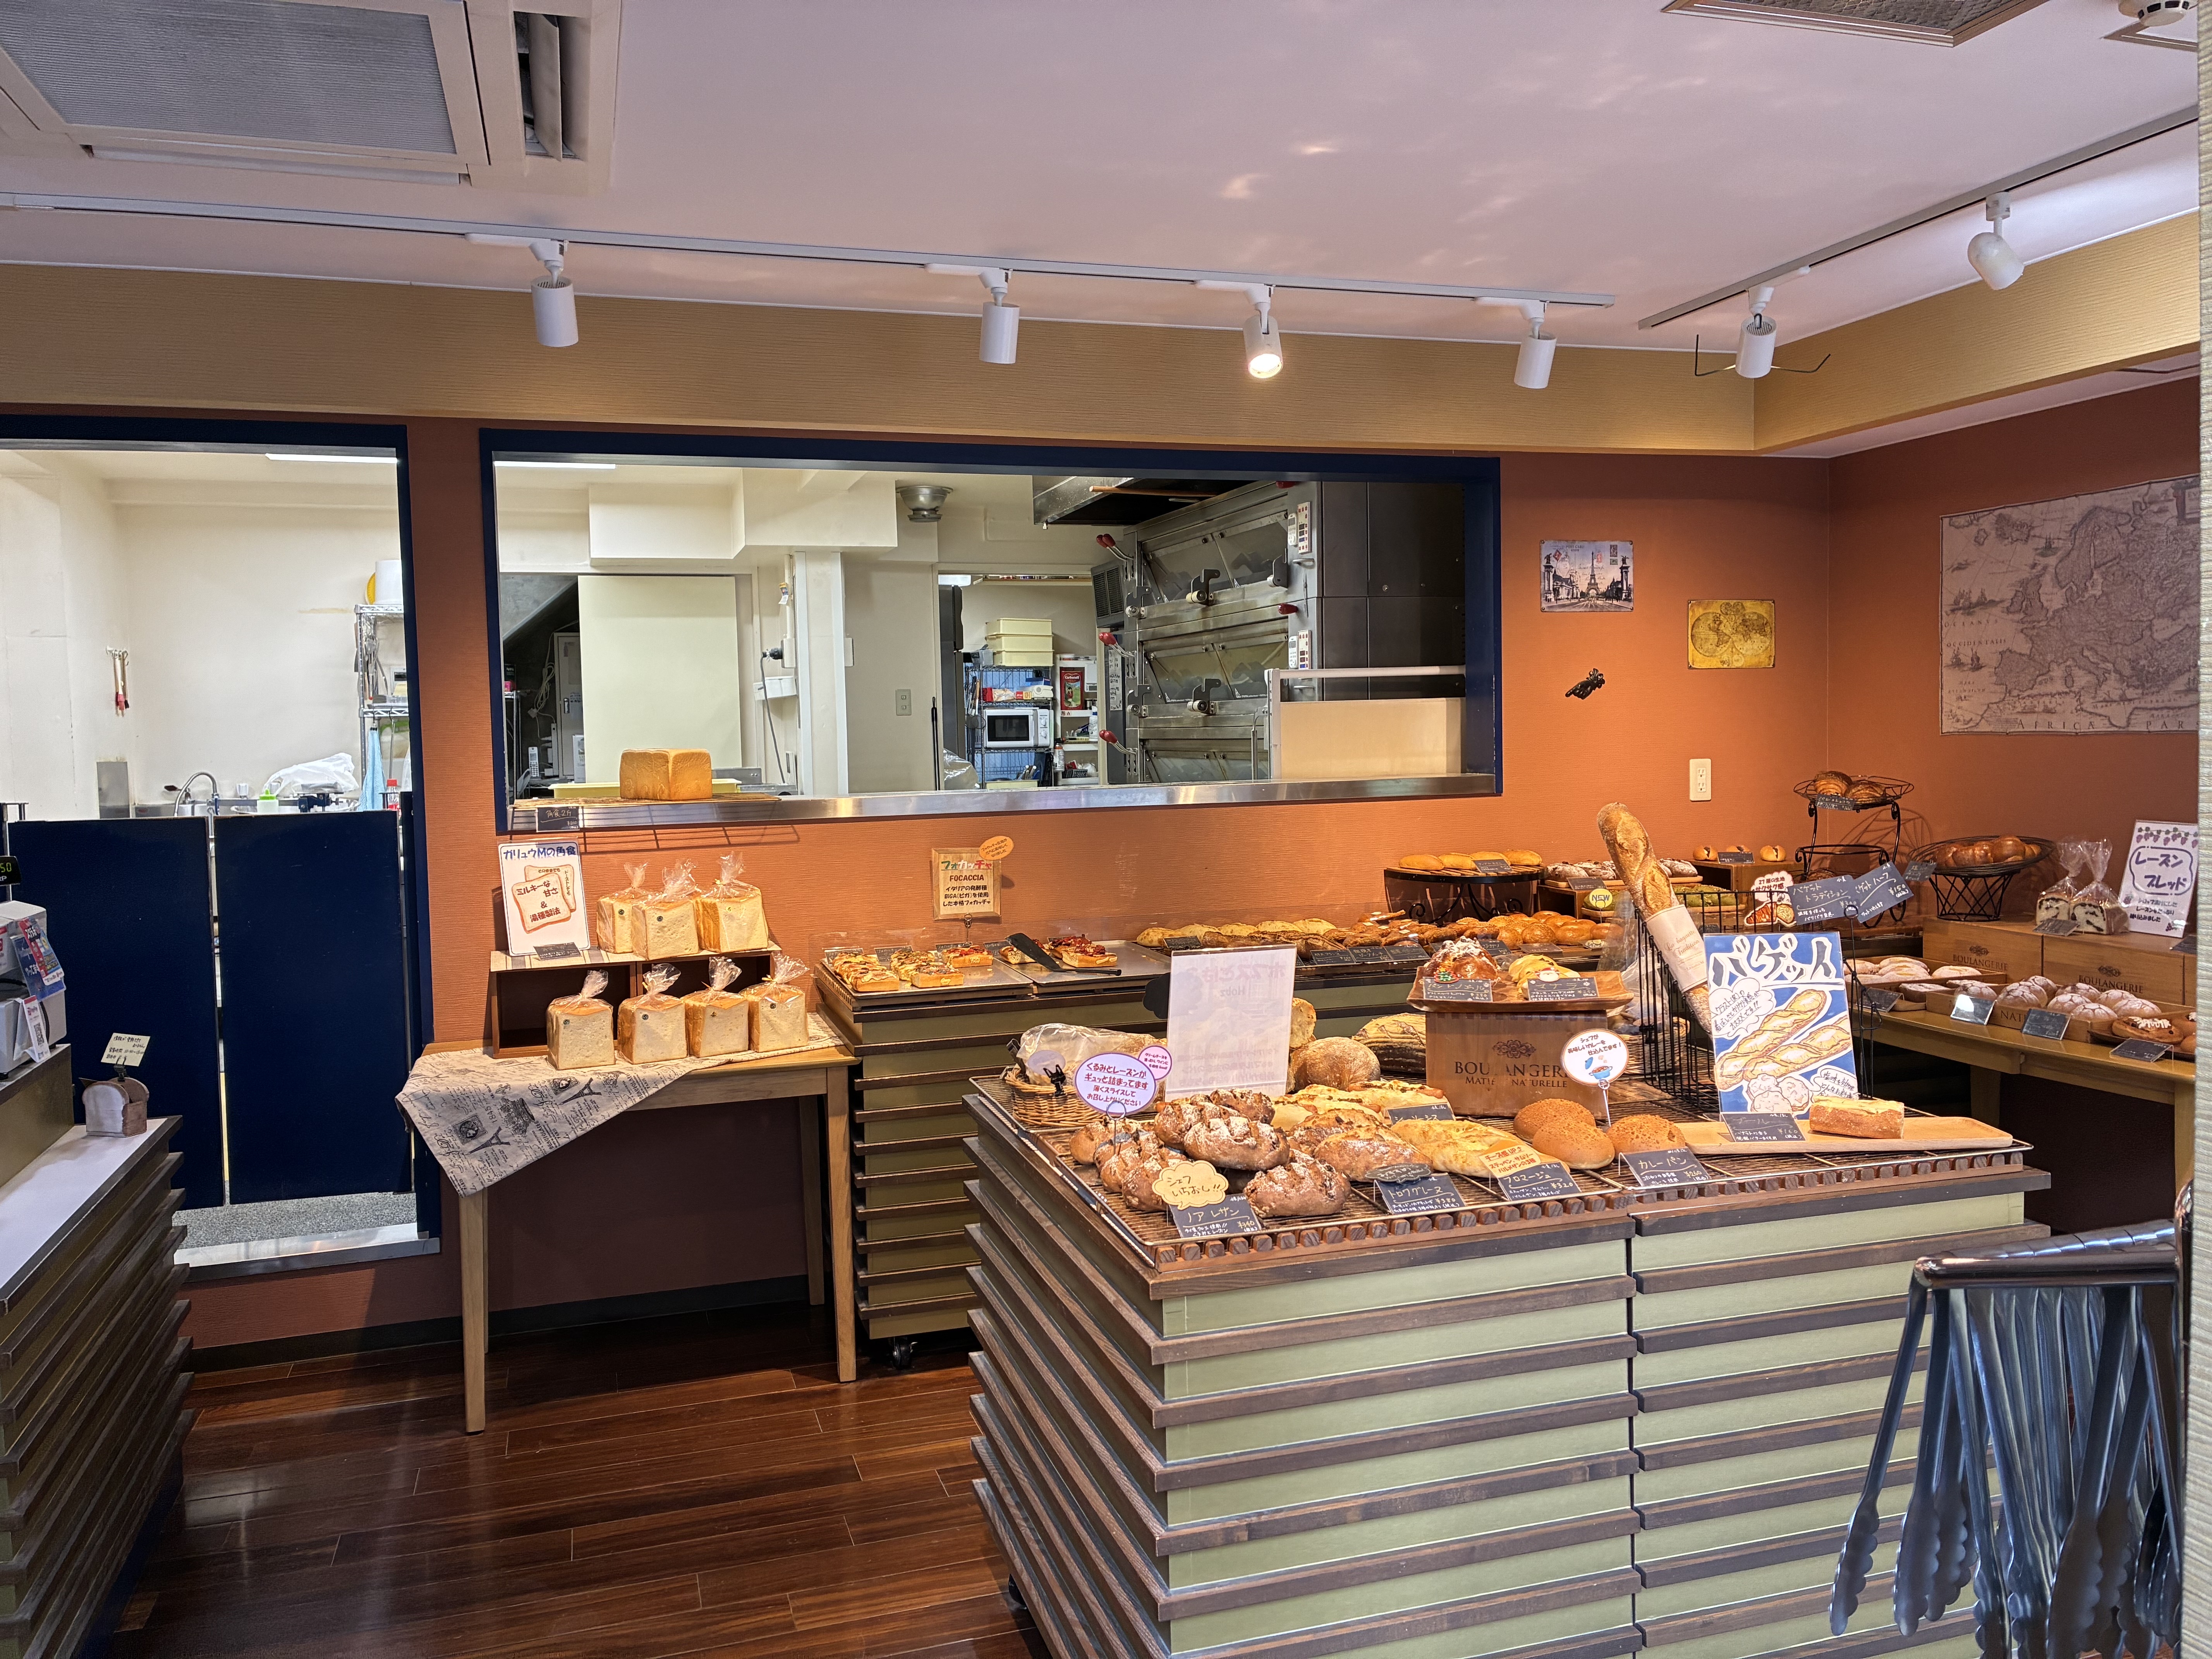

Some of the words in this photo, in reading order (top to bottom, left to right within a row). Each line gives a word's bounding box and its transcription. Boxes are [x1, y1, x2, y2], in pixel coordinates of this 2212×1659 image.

[941, 860, 992, 870] フォカッチャ
[516, 880, 551, 895] ミルキーな
[543, 888, 558, 897] 甘さ
[1712, 937, 1832, 987] バゲット
[1087, 1063, 1146, 1078] くるみとレーズンが
[1085, 1073, 1148, 1089] ギュッと詰まってます
[1168, 1176, 1191, 1187] シェフ
